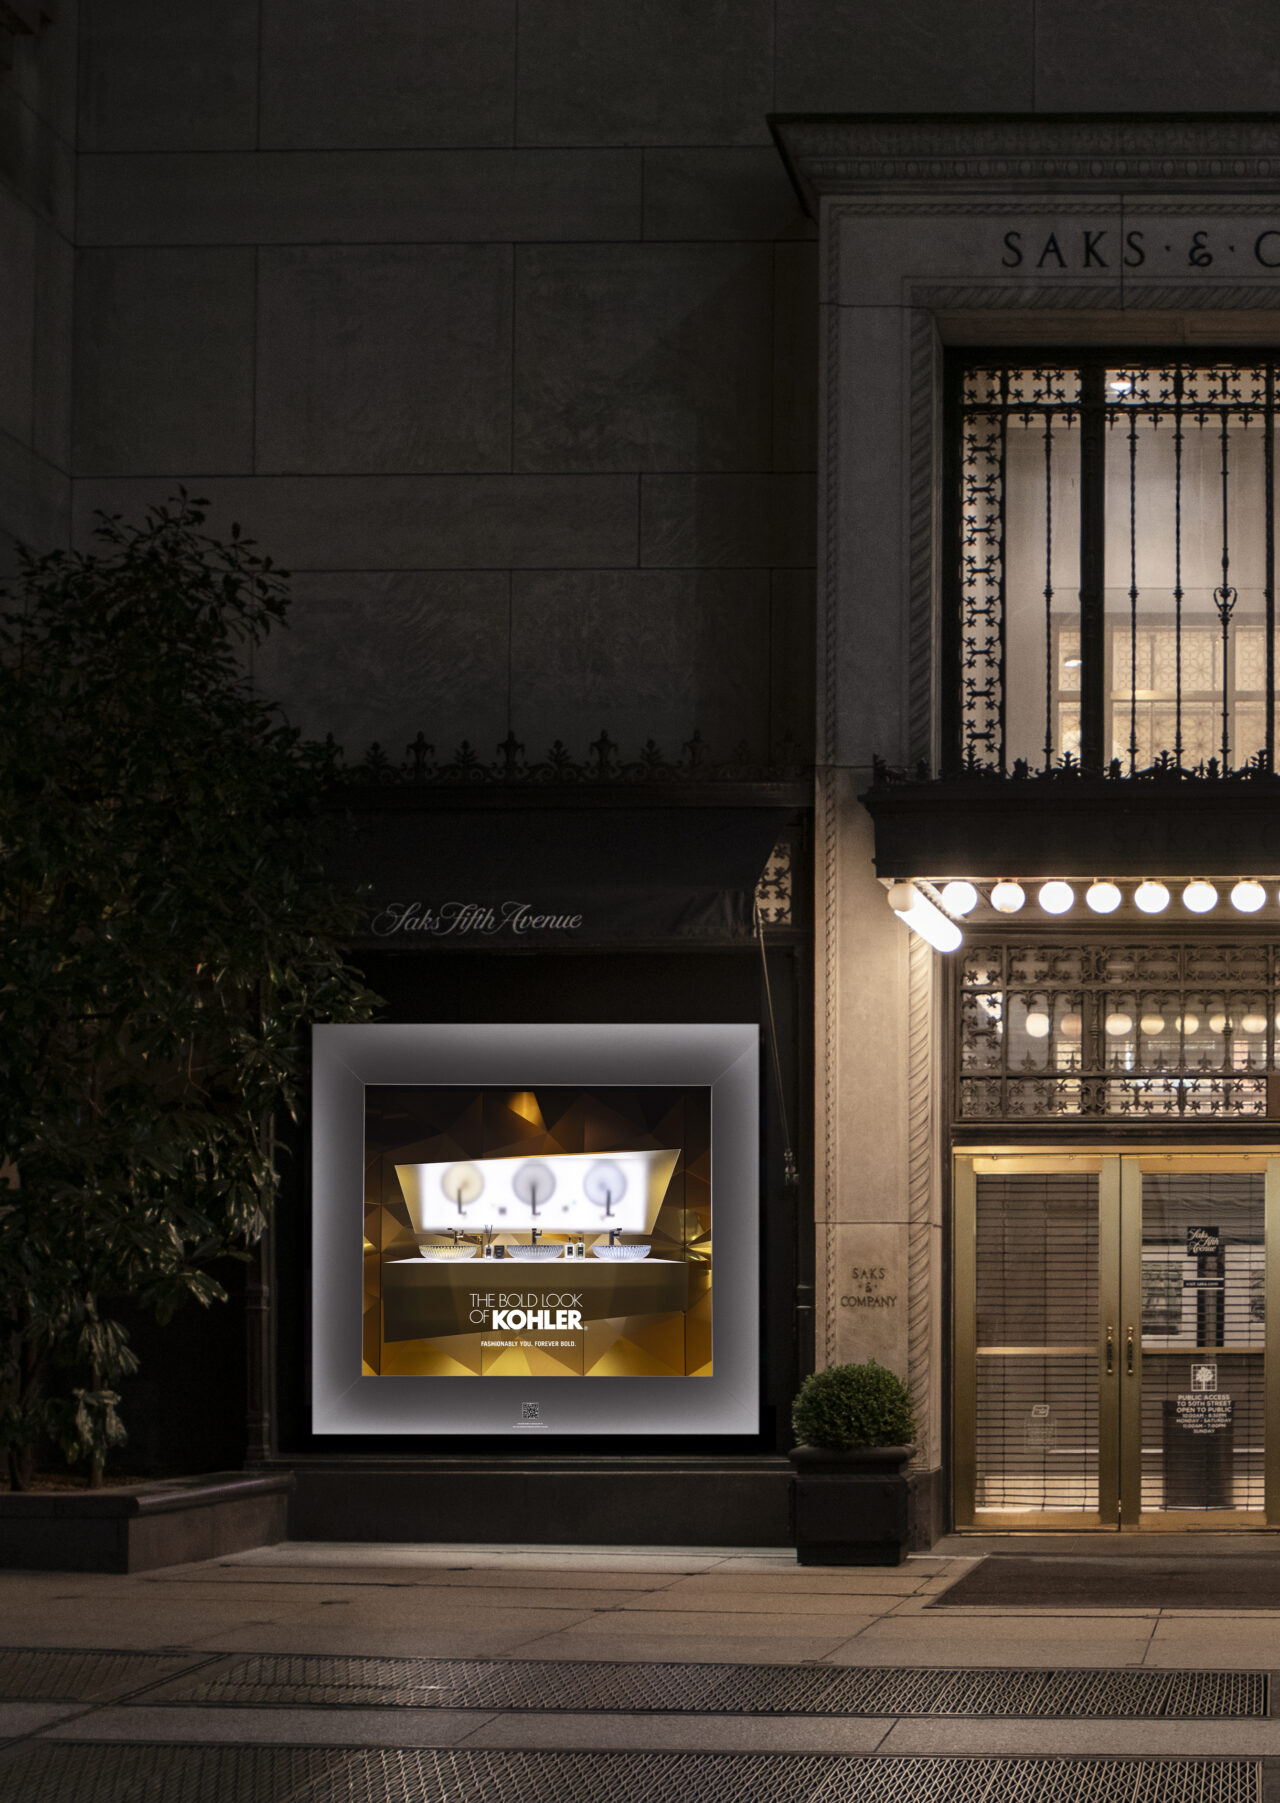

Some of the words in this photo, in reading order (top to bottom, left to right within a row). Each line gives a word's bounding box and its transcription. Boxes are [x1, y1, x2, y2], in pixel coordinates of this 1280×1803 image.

[1001, 231, 1147, 268] SAKS
[371, 902, 440, 937] Saks
[431, 901, 498, 936] Fifth
[482, 901, 583, 935] Avenue
[852, 1267, 885, 1280] SAKS
[469, 1293, 496, 1308] THE
[499, 1293, 538, 1308] BOLD
[542, 1293, 583, 1308] LOOK
[840, 1295, 897, 1308] COMPANY
[469, 1309, 490, 1324] OF
